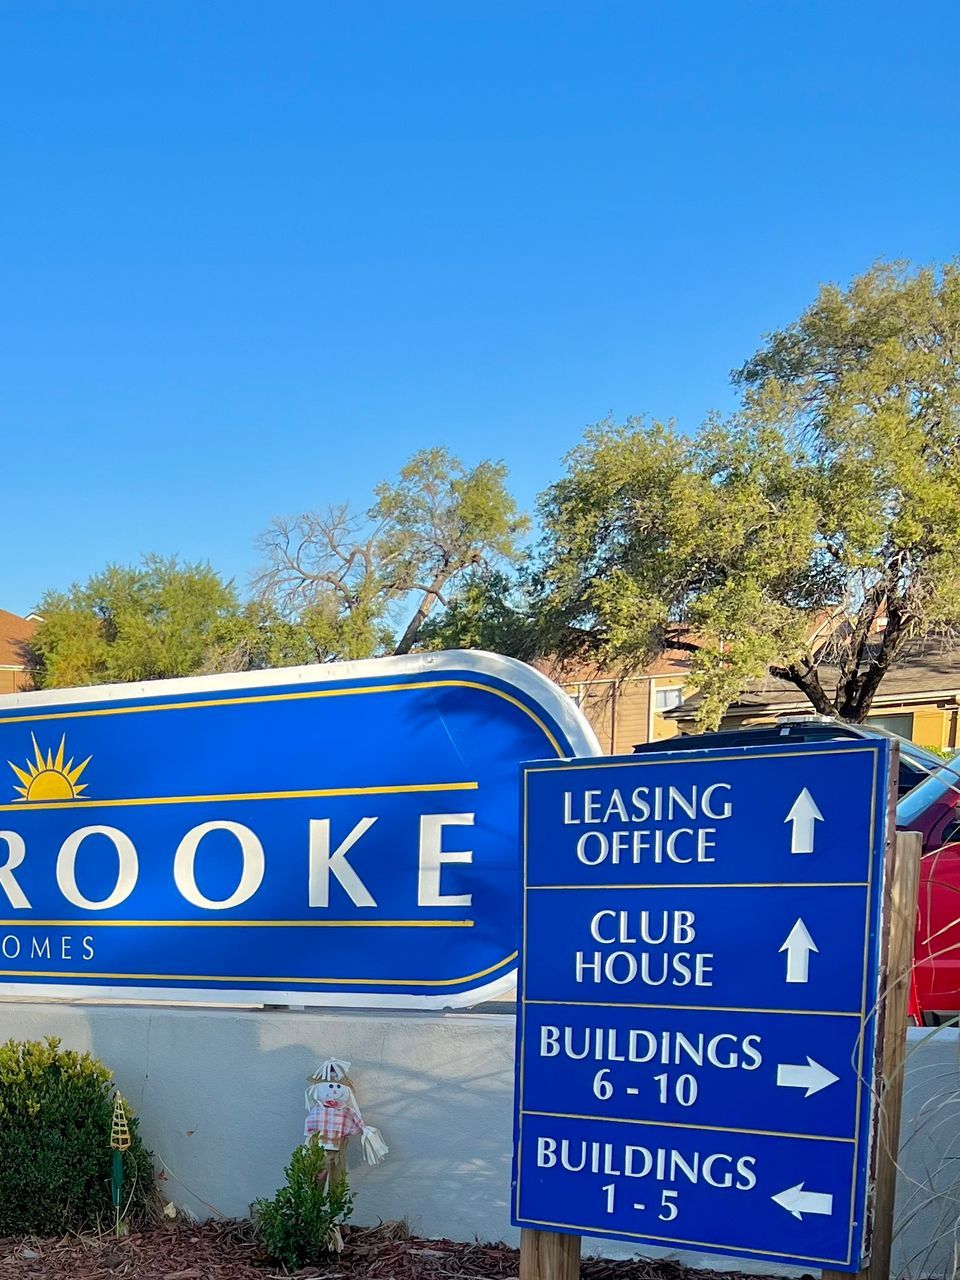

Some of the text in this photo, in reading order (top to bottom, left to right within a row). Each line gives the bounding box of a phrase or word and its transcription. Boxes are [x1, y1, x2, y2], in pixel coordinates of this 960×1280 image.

[563, 783, 733, 825] LEASING
[576, 828, 717, 866] OFFICE
[590, 909, 697, 945] CLUB
[575, 951, 714, 987] HOUSE
[539, 1025, 763, 1071] BUILDINGS
[593, 1068, 614, 1100] 6
[653, 1073, 698, 1107] 10
[537, 1136, 758, 1191] BUILDINGS
[602, 1183, 615, 1214] 1
[658, 1189, 679, 1221] 5
